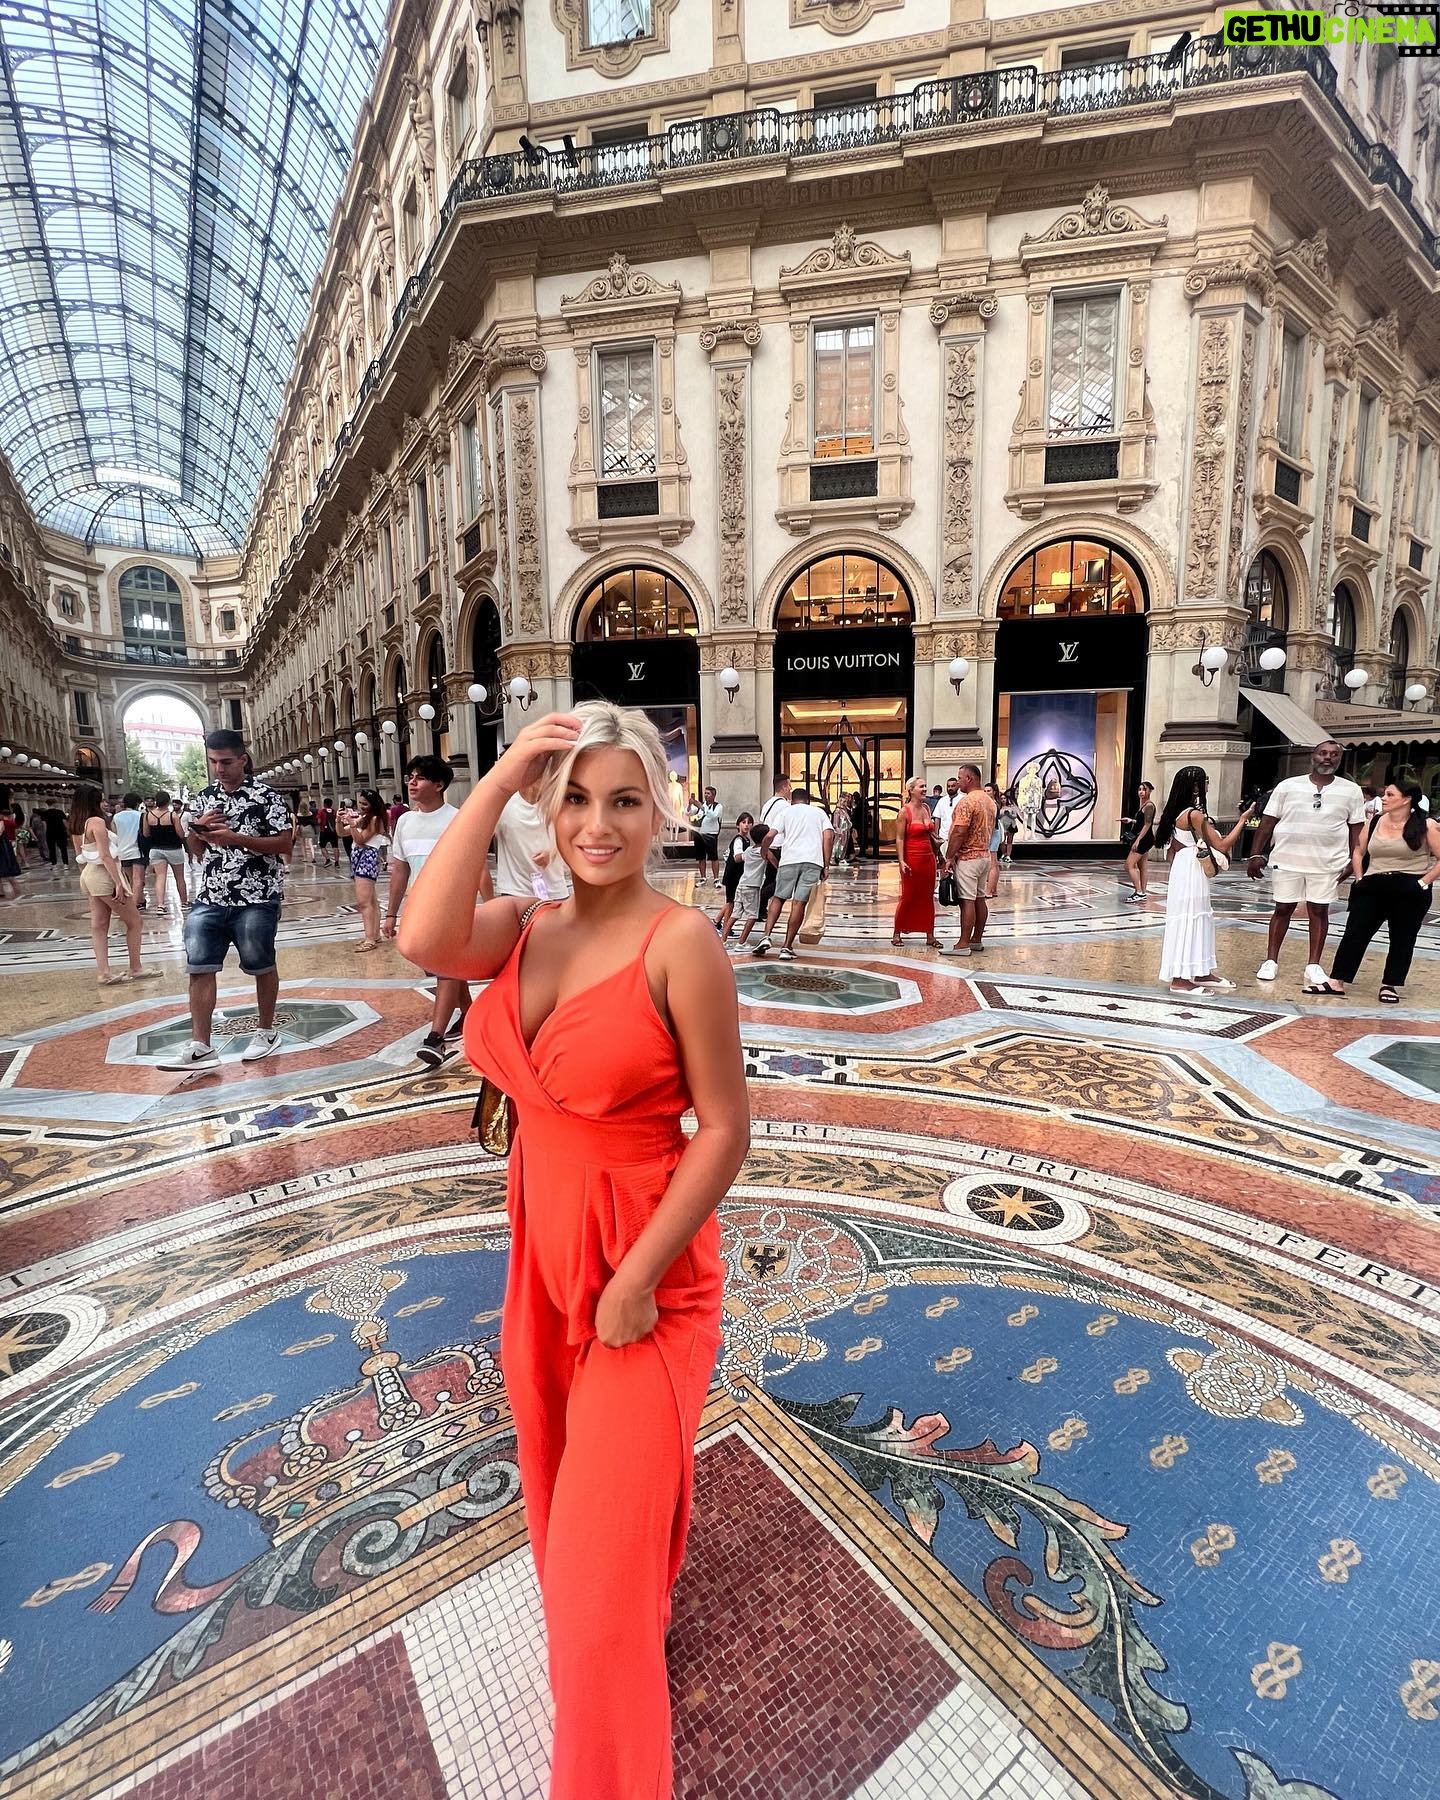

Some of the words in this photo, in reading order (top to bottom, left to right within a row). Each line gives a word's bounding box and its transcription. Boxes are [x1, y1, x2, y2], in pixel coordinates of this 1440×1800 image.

[787, 656, 830, 670] LOUIS
[833, 652, 900, 669] VUITTON
[979, 1149, 1088, 1181] FERT
[249, 1165, 363, 1205] FERT
[1276, 1232, 1440, 1299] FERT
